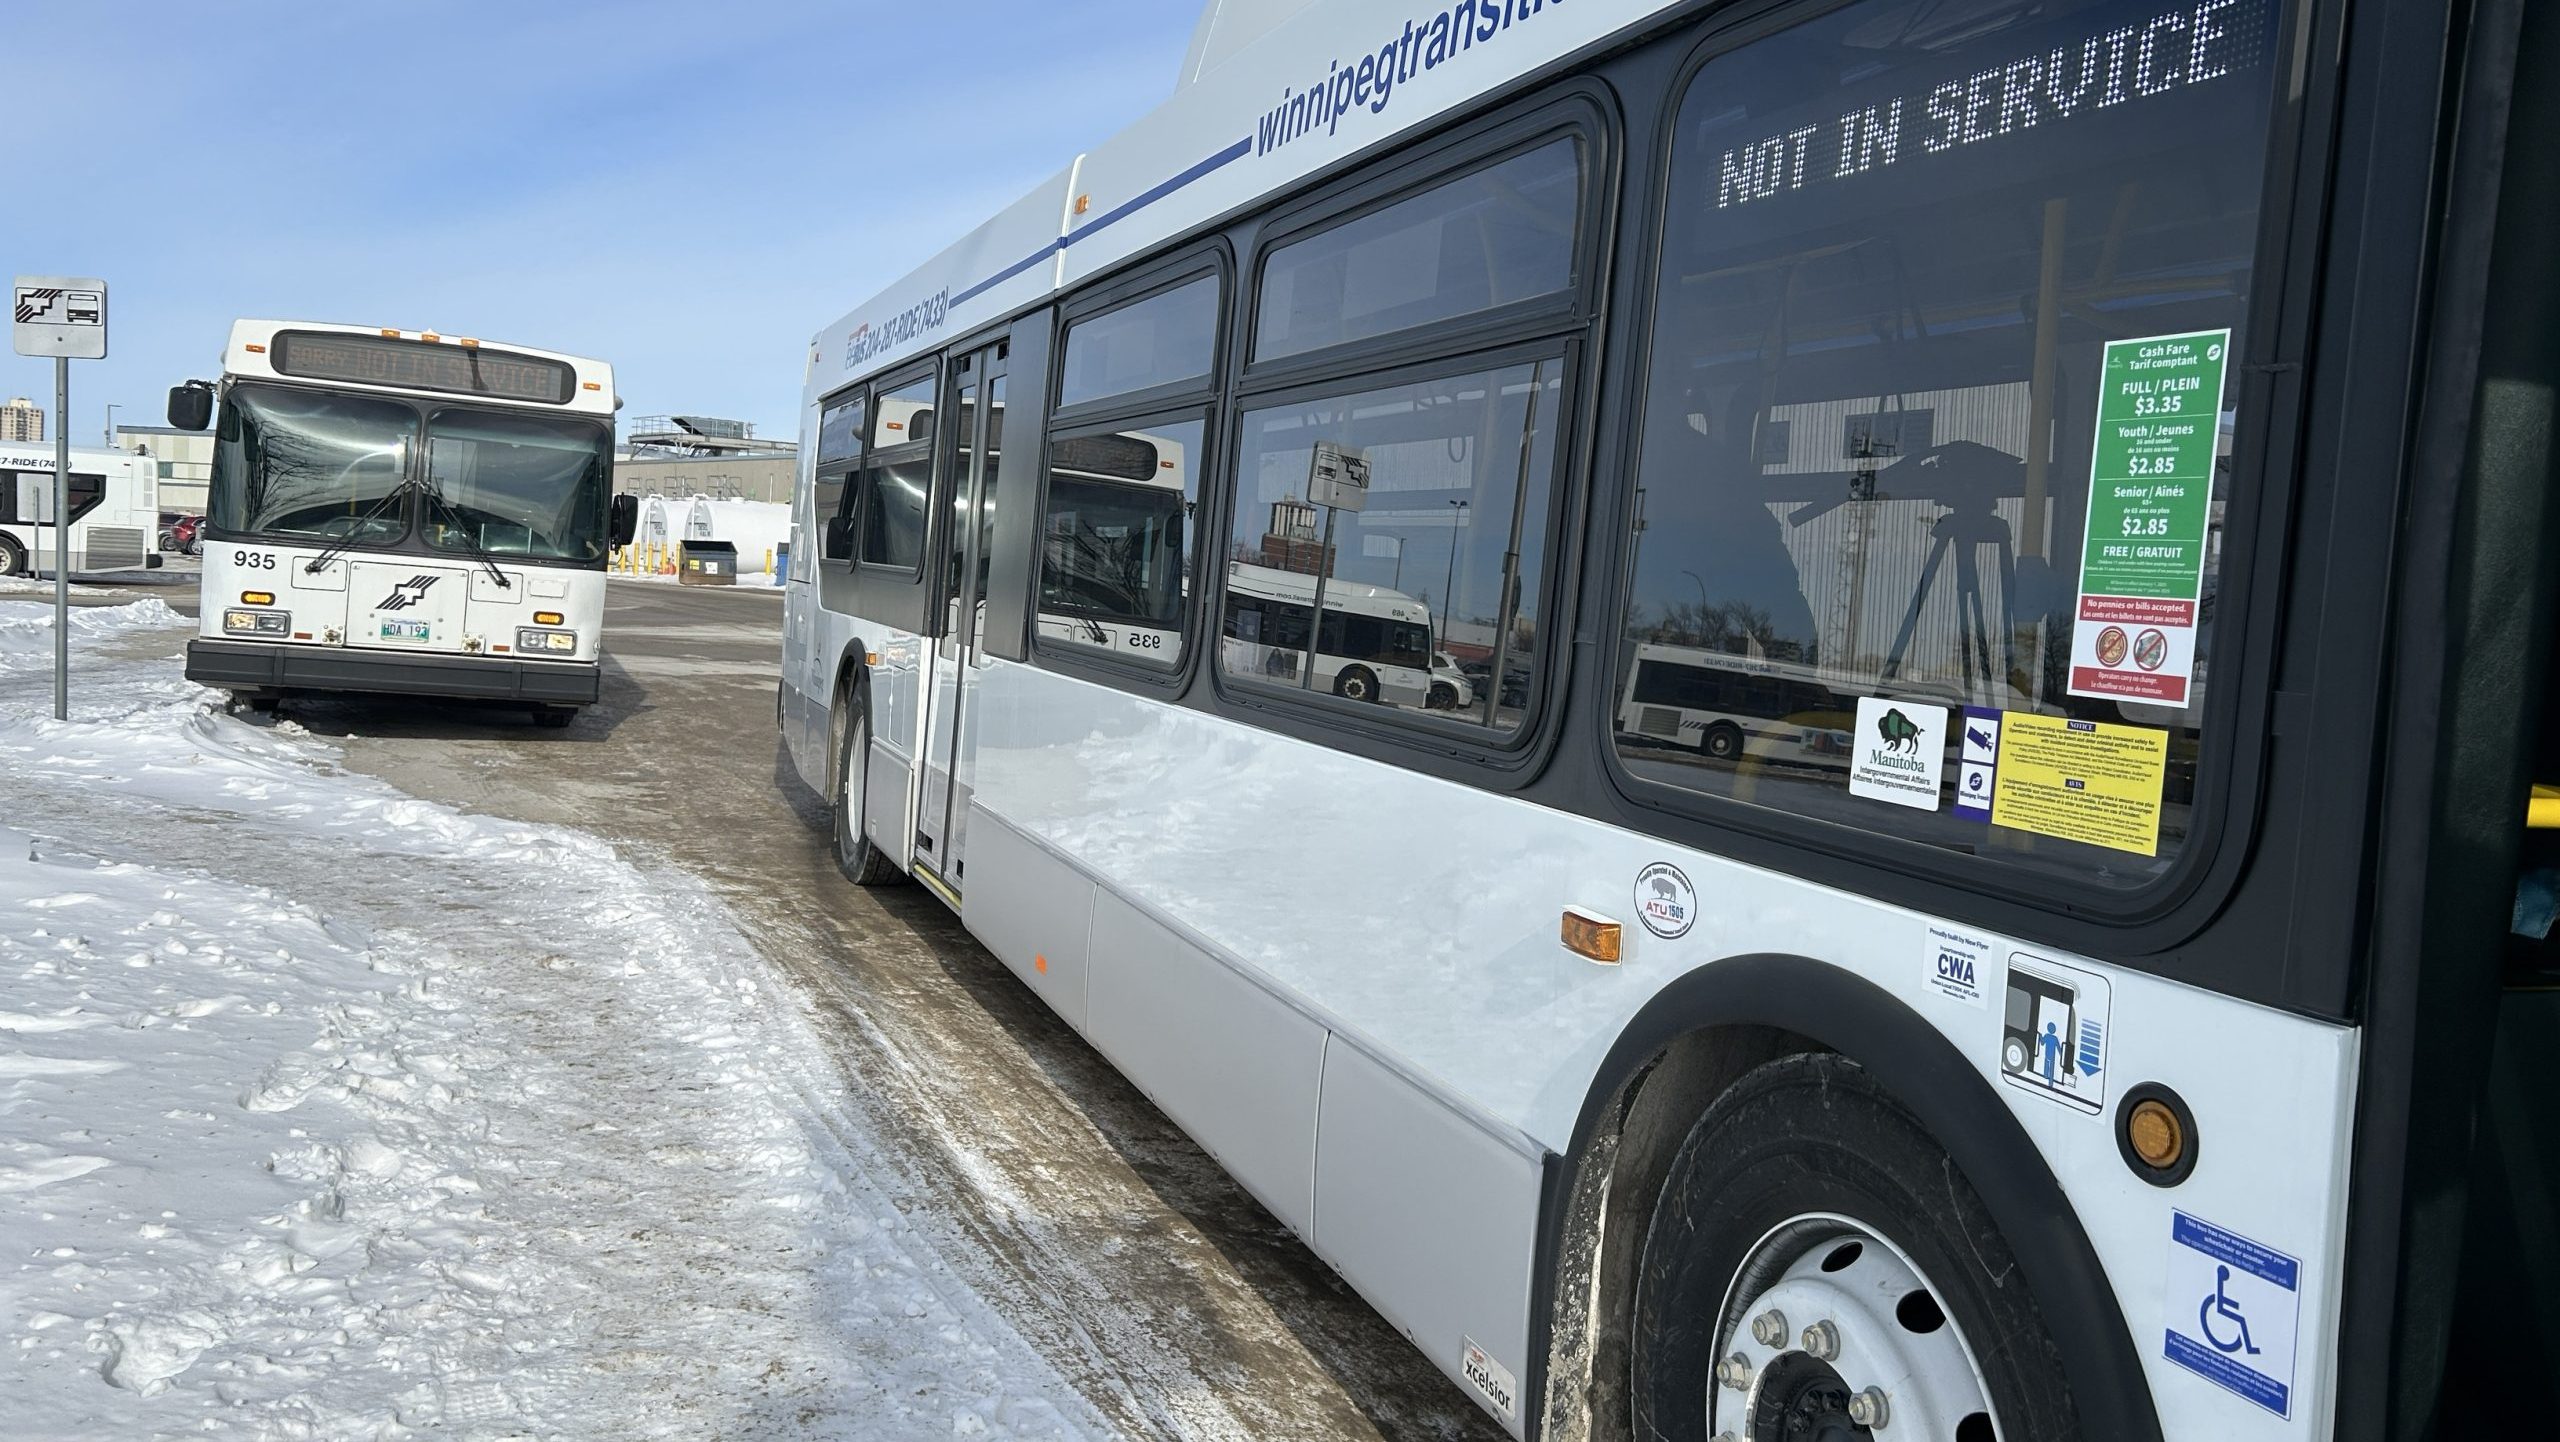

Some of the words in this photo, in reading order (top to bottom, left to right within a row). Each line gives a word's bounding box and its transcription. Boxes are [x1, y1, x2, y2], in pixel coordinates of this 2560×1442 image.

[1717, 122, 1817, 209] NOT
[1836, 96, 1903, 178] IN
[1924, 0, 2235, 153] SERVICE
[917, 285, 949, 338] (7433)
[2139, 345, 2164, 358] Cash
[2166, 344, 2190, 355] Fare
[356, 351, 398, 378] NOT
[411, 354, 437, 385] IN
[2130, 360, 2151, 370] Tarif
[2153, 354, 2198, 369] comptant
[2122, 381, 2152, 395] FULL
[2154, 378, 2160, 395] /
[2162, 377, 2200, 392] PLEIN
[2135, 395, 2182, 416] $3.35
[2119, 425, 2148, 438] Youth
[2149, 425, 2154, 438] /
[2156, 425, 2194, 436] Jeunes
[39, 460, 73, 470] (74)
[2128, 456, 2175, 476] $2.85
[2114, 486, 2148, 498] Senior
[2148, 485, 2154, 499] /
[2155, 484, 2184, 497] Aînés
[2122, 516, 2168, 536] $2.85
[234, 550, 276, 570] 935
[2103, 546, 2128, 556] FREE
[2130, 546, 2135, 559] /
[2136, 547, 2182, 558] GRATUIT
[2087, 599, 2097, 608] No
[2098, 600, 2126, 610] pennies
[2136, 602, 2150, 610] bills
[2152, 604, 2186, 613] accepted.
[383, 623, 402, 636] HDA
[410, 625, 428, 638] 193
[2069, 722, 2094, 731] NOTICE
[1870, 749, 1925, 773] Manitoba
[1852, 773, 1872, 784] Affaires
[1860, 766, 1910, 782] Intergovernmental
[1911, 773, 1930, 786] Affairs
[2068, 780, 2082, 788] AVIS
[1646, 902, 1667, 915] ATU
[1669, 905, 1684, 919] 1505
[1938, 954, 1975, 984] CWA
[1466, 1361, 1510, 1410] xcelsior
